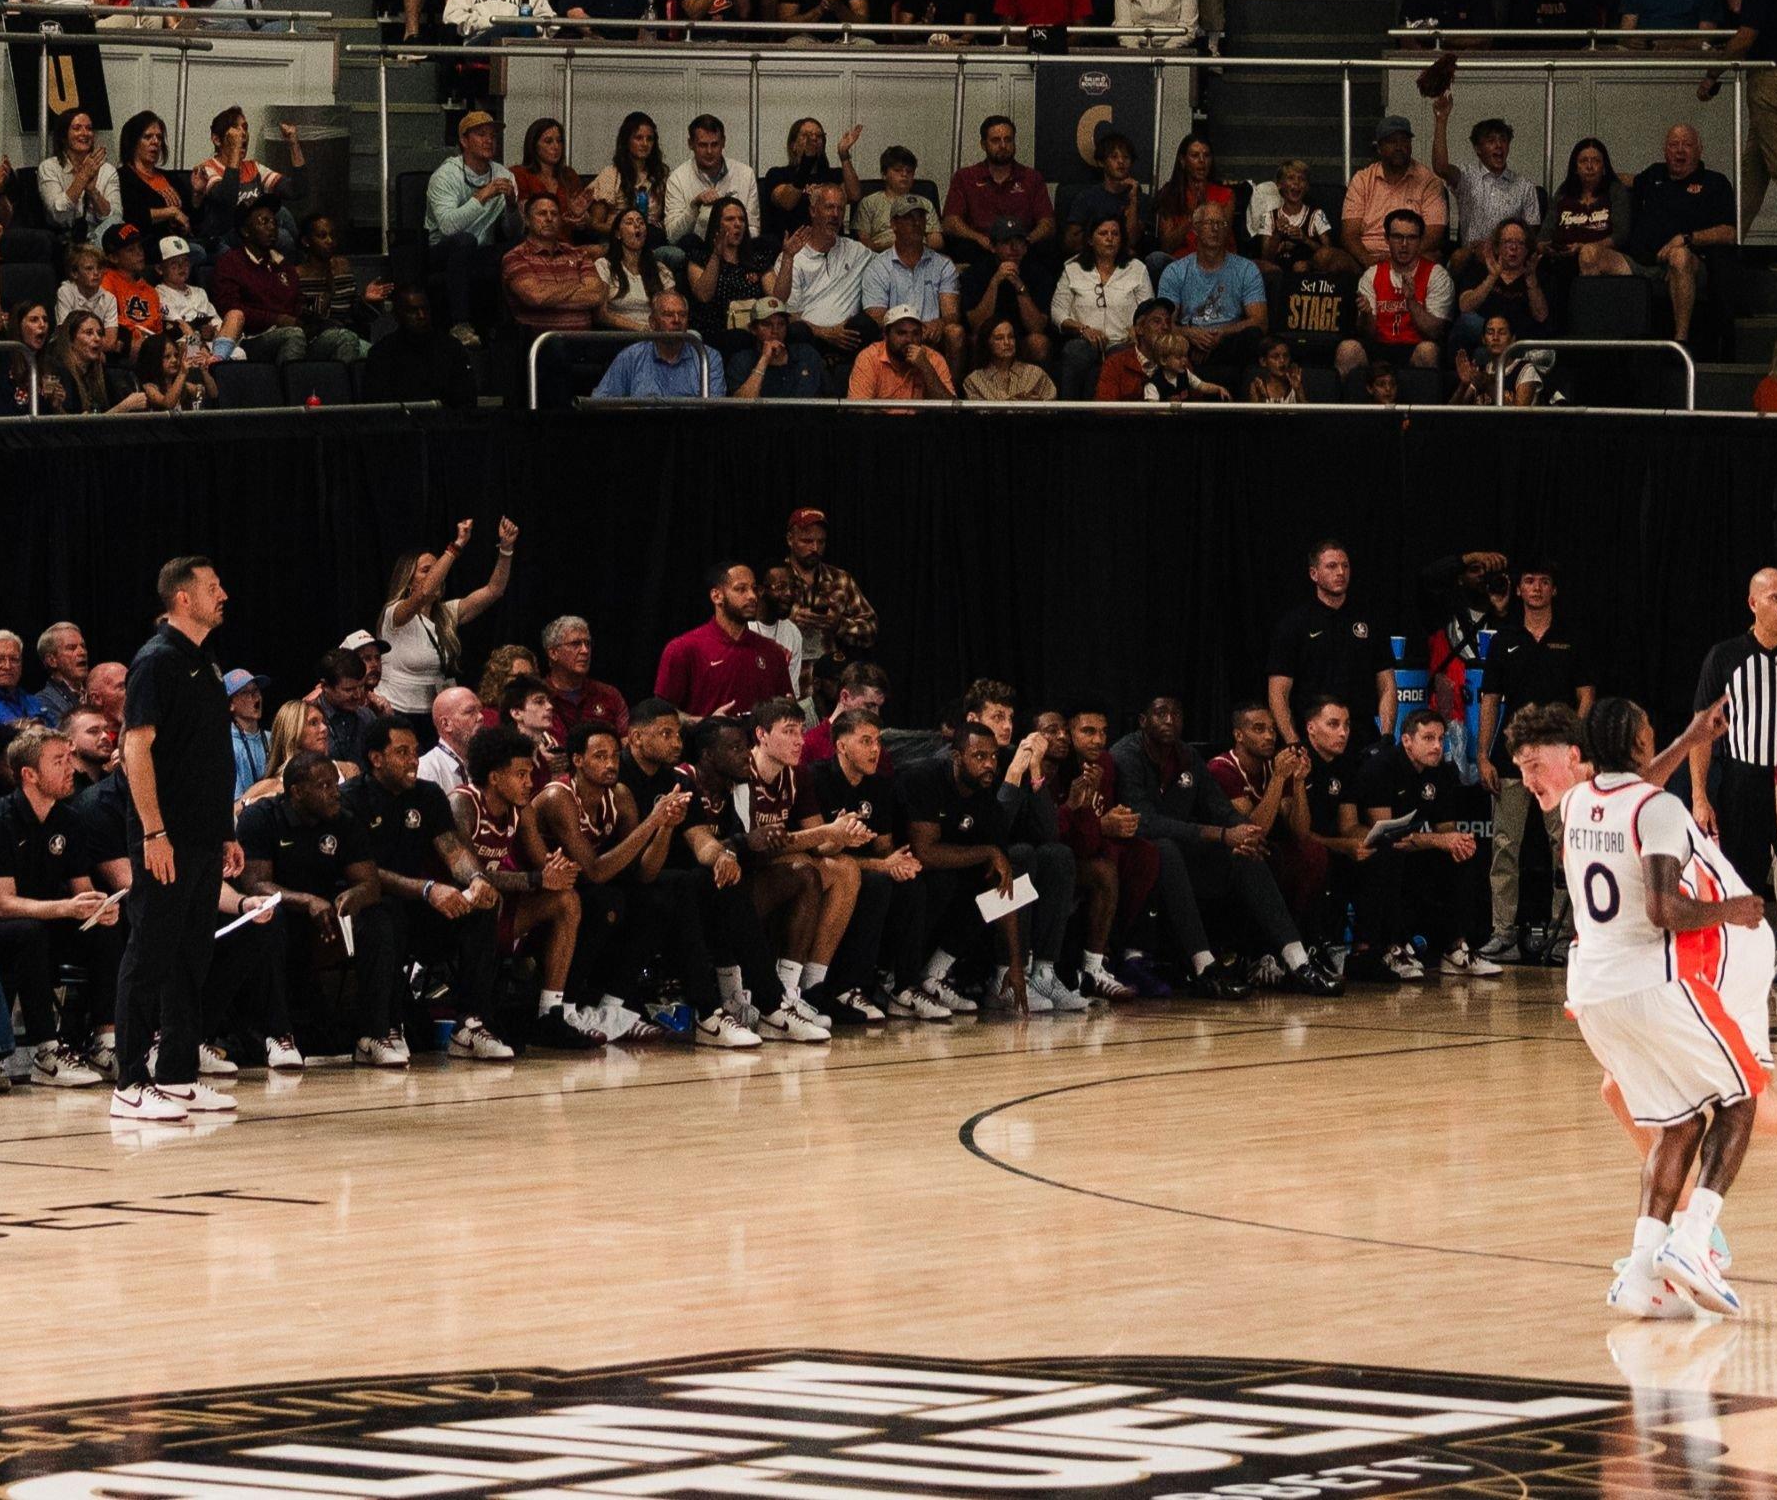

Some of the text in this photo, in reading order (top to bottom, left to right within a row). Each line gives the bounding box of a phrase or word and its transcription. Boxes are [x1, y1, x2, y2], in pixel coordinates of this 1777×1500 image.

[1301, 279, 1336, 293] Set The
[1287, 294, 1342, 331] STAGE
[1397, 689, 1424, 702] RADE
[1568, 828, 1625, 854] PETTIFORD
[1584, 862, 1620, 924] 0
[1152, 1455, 1476, 1500] BETT
